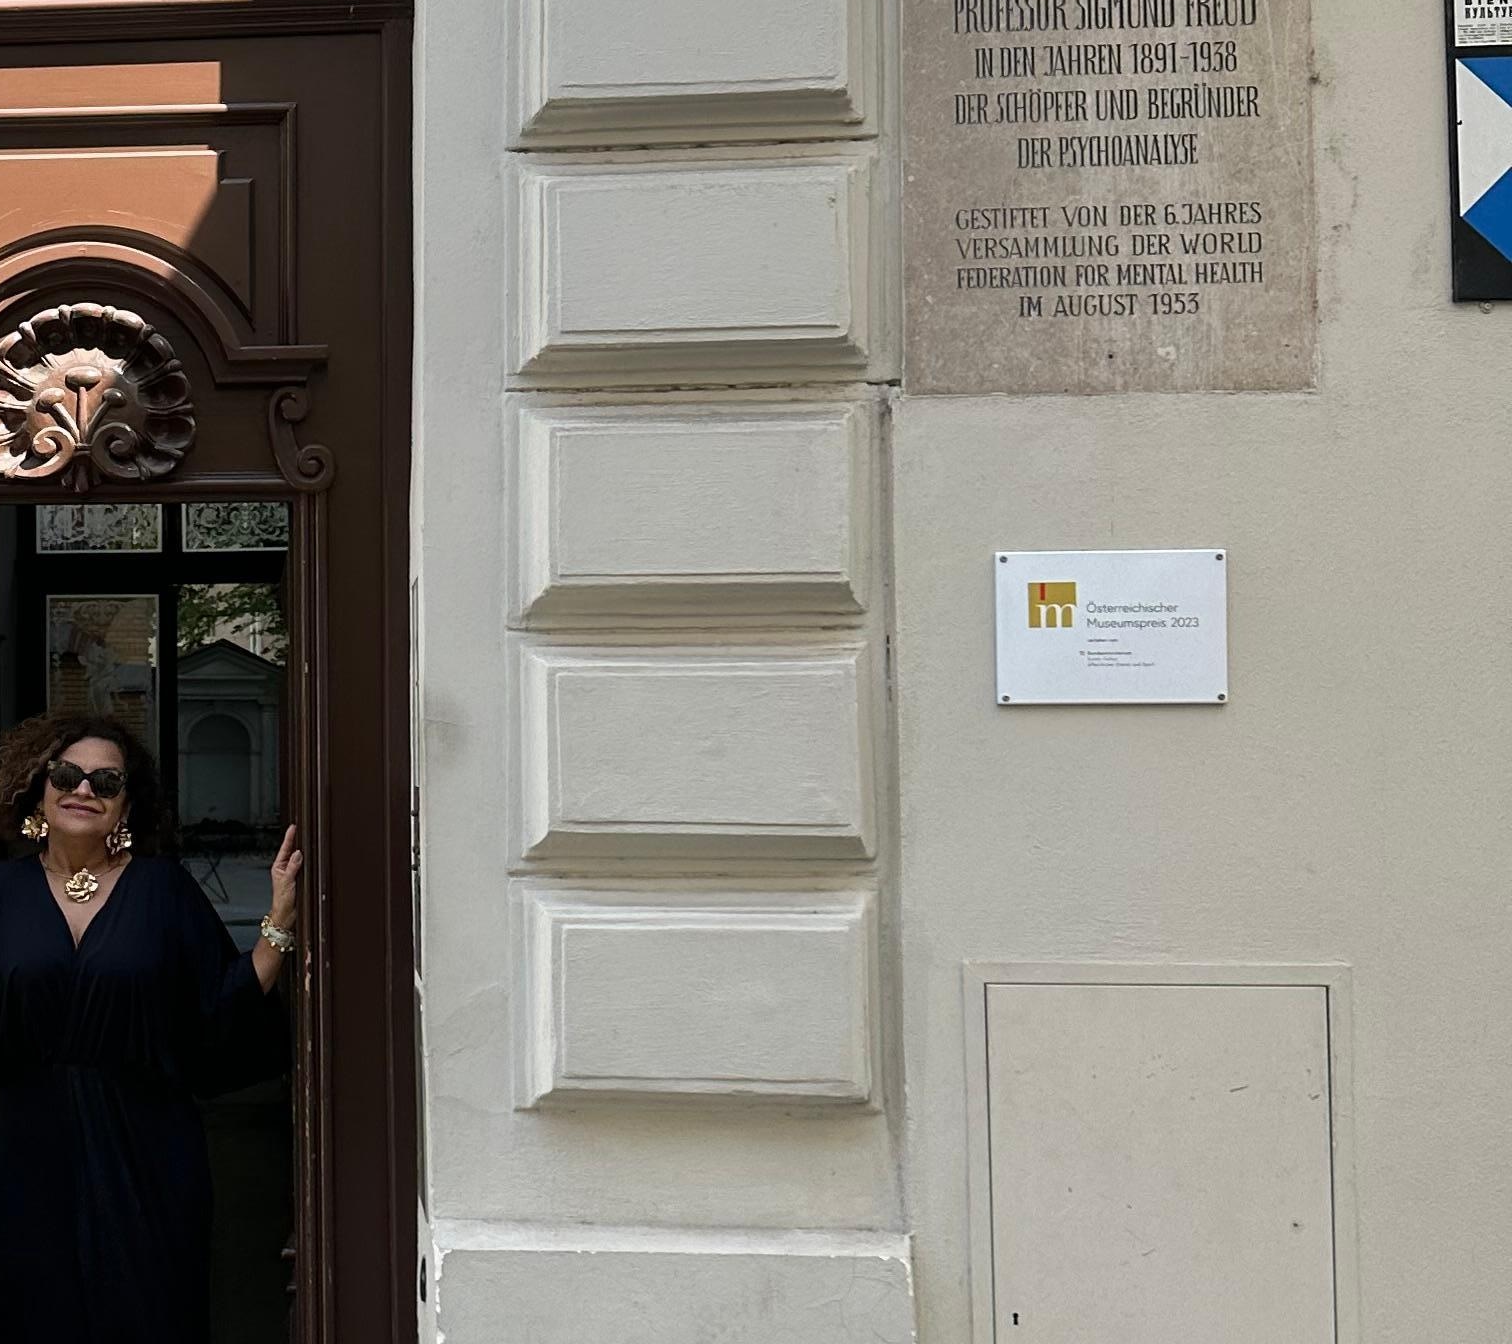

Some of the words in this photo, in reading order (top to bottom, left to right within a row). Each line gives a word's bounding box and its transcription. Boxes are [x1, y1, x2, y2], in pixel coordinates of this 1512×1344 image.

[975, 47, 993, 80] IN
[1000, 46, 1036, 78] DEN
[1044, 43, 1122, 77] JAHREN
[955, 93, 988, 125] DER
[995, 88, 1088, 124] SCHÖPFER
[1095, 88, 1138, 121] UND
[1147, 83, 1260, 120] BEGRÜNDER
[1017, 138, 1051, 169] DER
[1059, 134, 1199, 167] PSYCHOANALYSE
[955, 206, 1050, 231] GESTIFTET
[1061, 206, 1107, 228] VON
[1120, 204, 1156, 226] DER
[956, 234, 1119, 260] VERSAMMLUNG
[1132, 233, 1170, 256] DER
[1179, 232, 1262, 256] WORLD
[956, 265, 1067, 289] FEDERATION
[1075, 264, 1108, 287] FOR
[1117, 262, 1188, 286] MENTAL
[1195, 261, 1264, 284] HEALTH
[1019, 295, 1042, 317] IM
[1053, 293, 1138, 317] AUGUST
[1148, 292, 1200, 316] 1953
[1087, 601, 1179, 613] Österreichischer
[1086, 617, 1167, 630] Museumspreis
[1171, 617, 1200, 628] 2023
